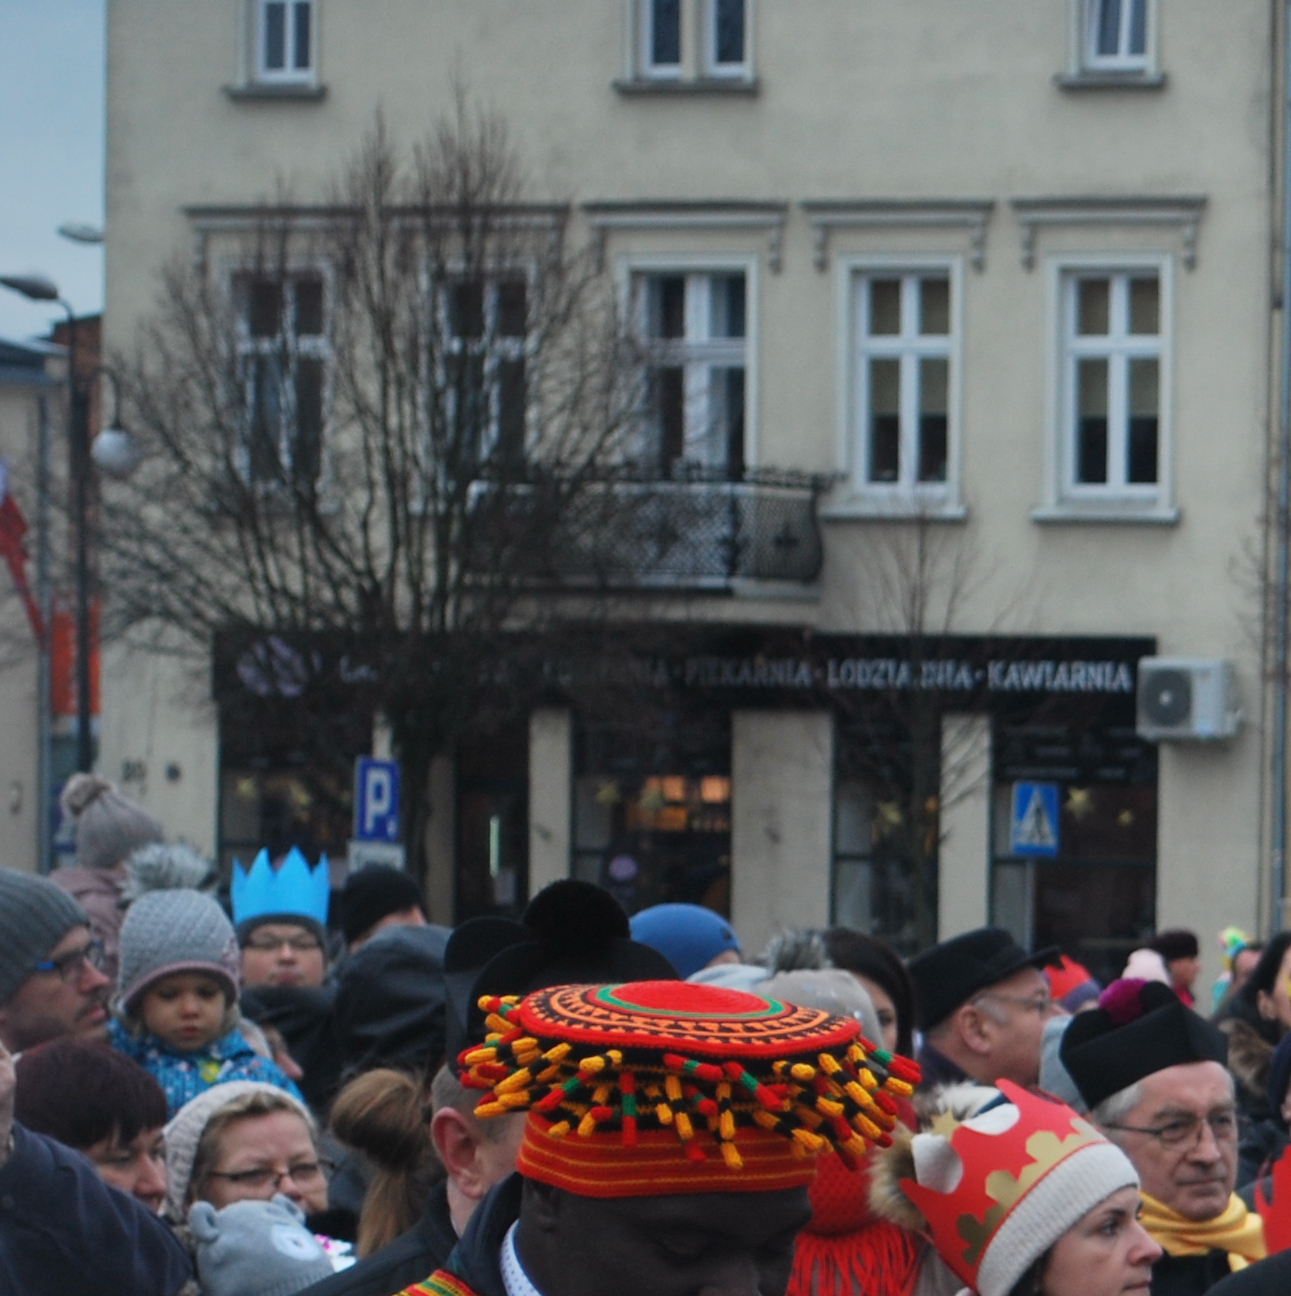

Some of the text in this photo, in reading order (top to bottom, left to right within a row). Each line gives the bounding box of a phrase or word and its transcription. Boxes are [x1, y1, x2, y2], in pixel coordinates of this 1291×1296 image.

[827, 658, 974, 690] LODZIANIA
[987, 659, 1134, 692] KAWIARNIA
[365, 767, 391, 834] P
